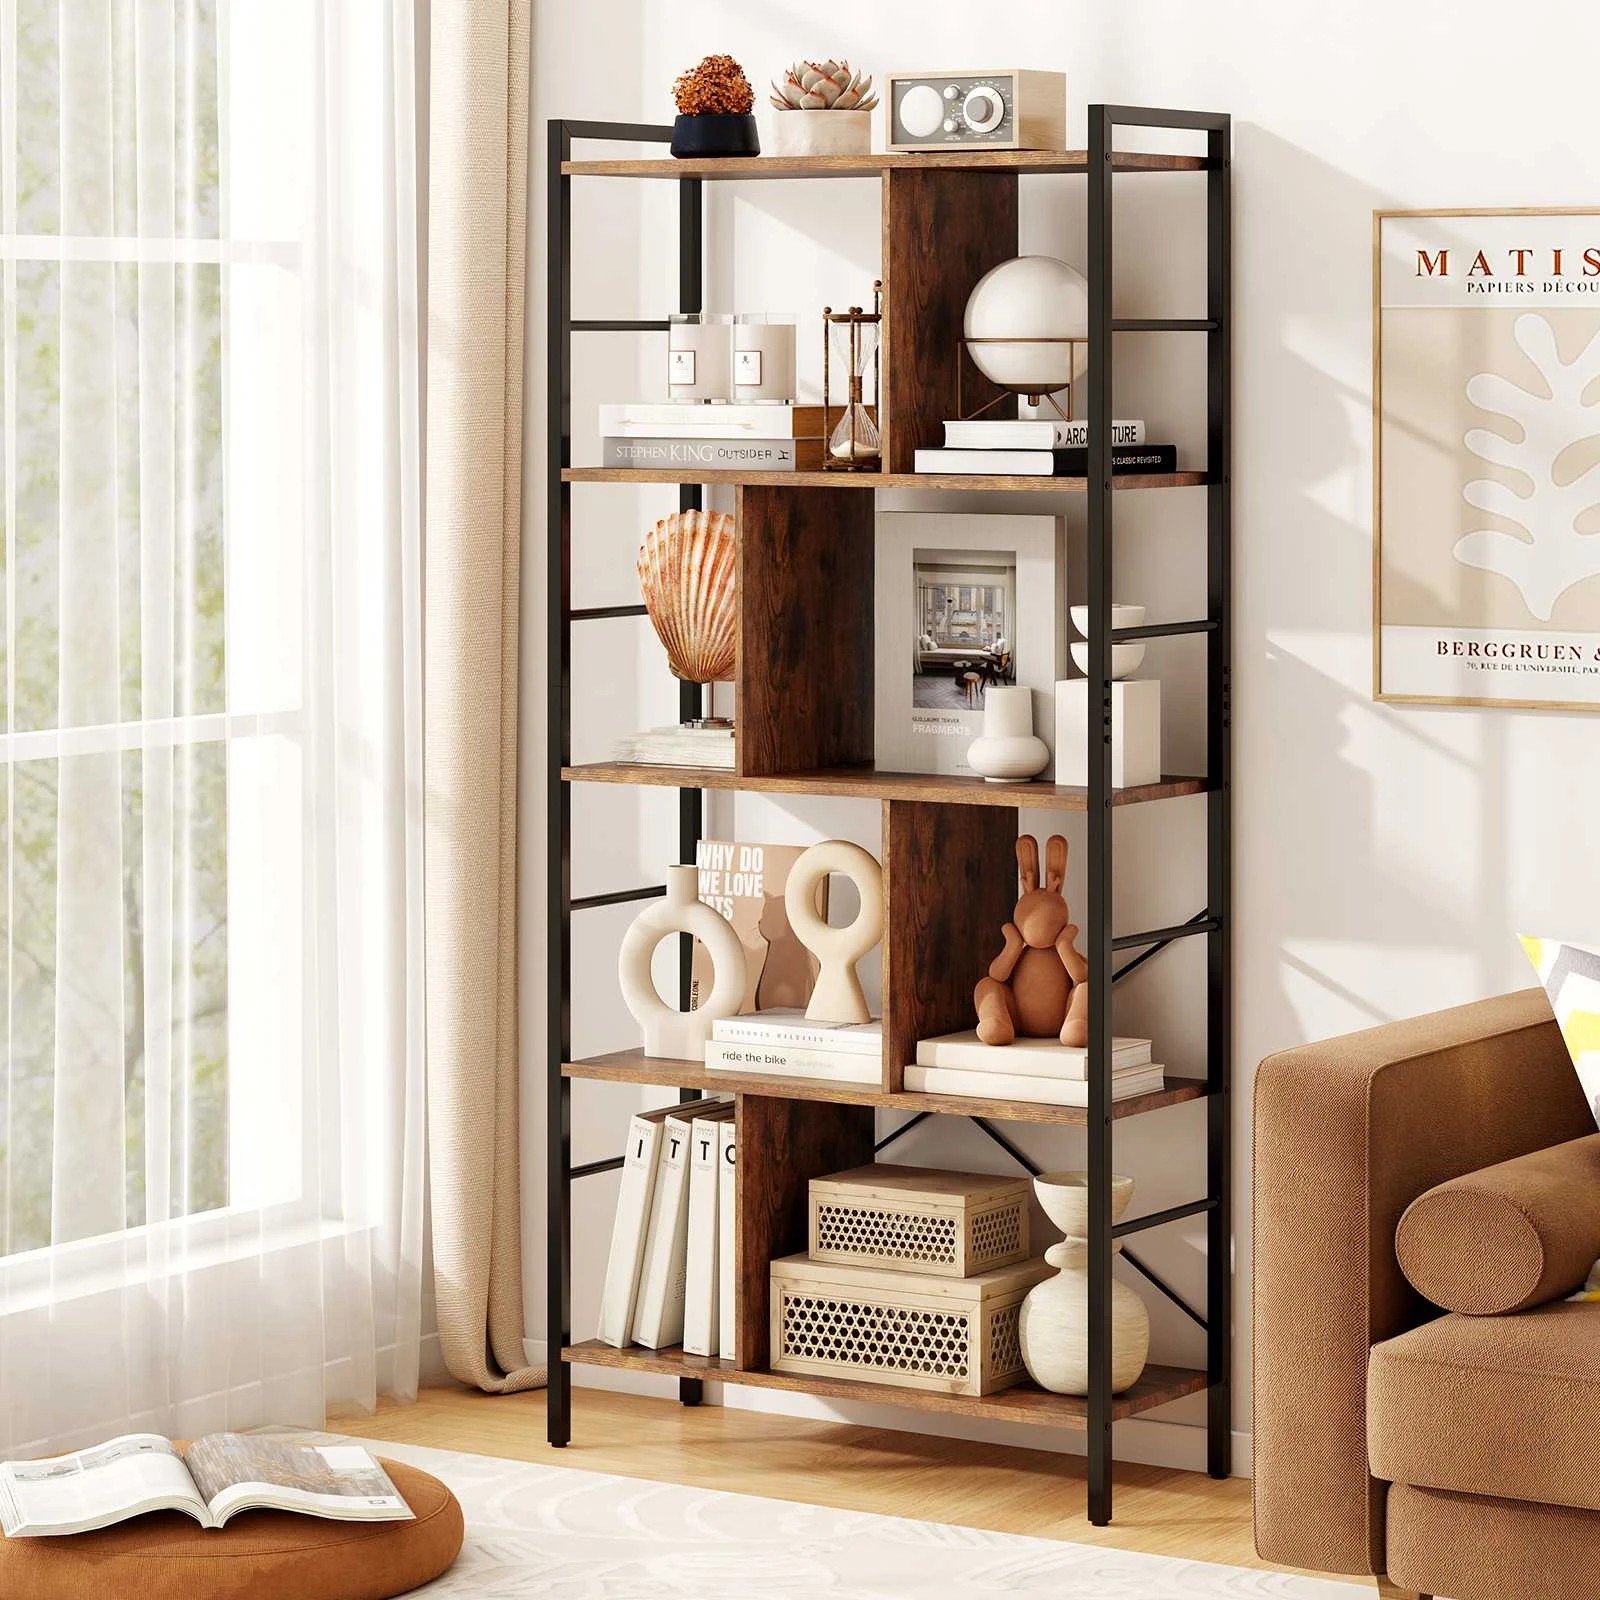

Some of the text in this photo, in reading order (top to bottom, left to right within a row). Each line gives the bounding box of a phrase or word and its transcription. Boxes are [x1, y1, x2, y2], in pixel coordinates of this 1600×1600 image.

[1467, 282, 1535, 293] PAPIERS
[616, 446, 668, 458] STEPHEN
[669, 444, 714, 462] KING
[717, 447, 772, 460] OUTSIDER
[1117, 456, 1137, 464] CLASSIC
[1137, 455, 1162, 464] REVISITED
[1437, 640, 1583, 660] BERGGRUEN
[1481, 663, 1499, 671] RUE
[912, 724, 970, 736] FRAGMENTS
[697, 842, 764, 873] WHY DO
[698, 871, 764, 898] WE LOVE
[722, 1050, 742, 1062] ride
[745, 1051, 762, 1063] the
[765, 1053, 787, 1066] bike
[670, 1138, 681, 1159] T
[700, 1140, 710, 1161] T
